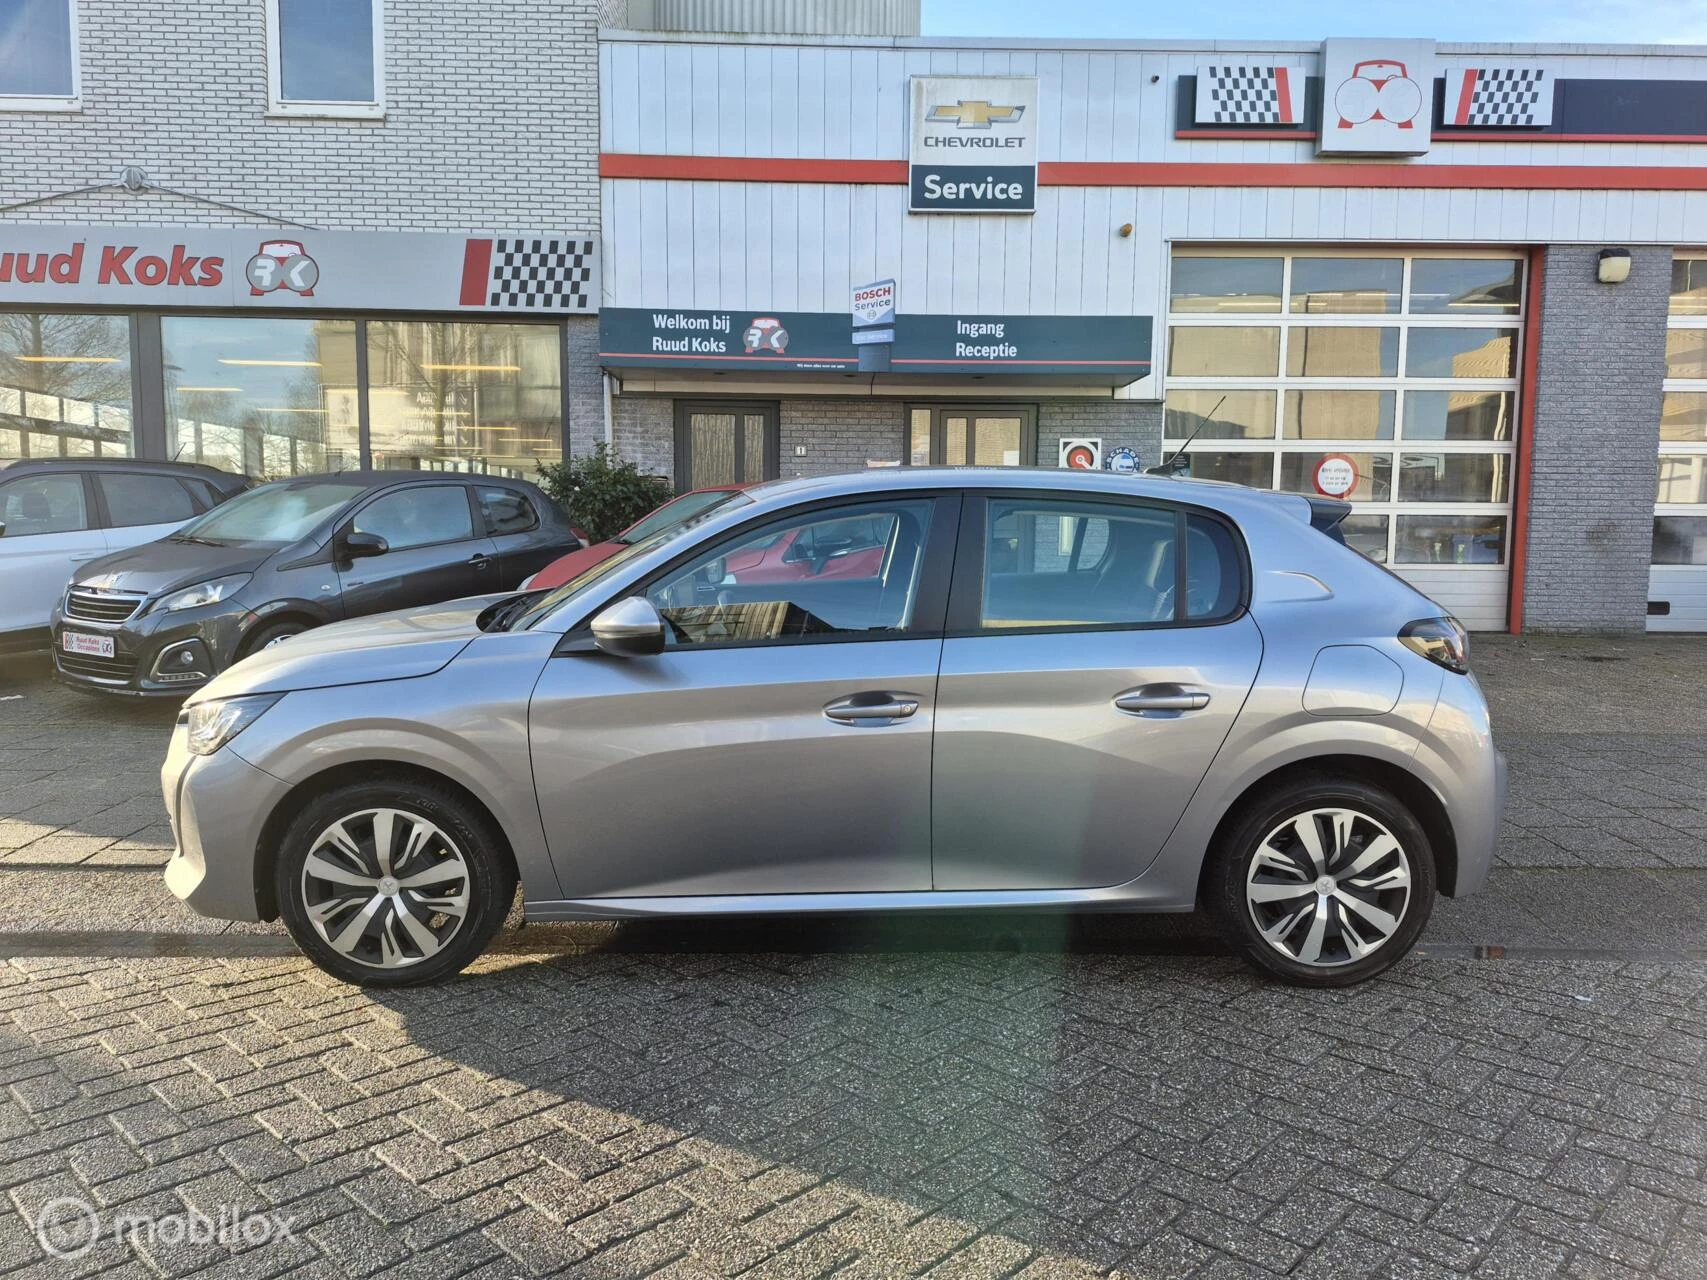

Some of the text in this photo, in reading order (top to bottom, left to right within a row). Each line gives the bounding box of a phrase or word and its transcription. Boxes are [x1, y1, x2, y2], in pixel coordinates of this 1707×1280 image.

[924, 136, 1026, 148] CHEVROLET
[924, 174, 1023, 200] Service
[98, 244, 225, 287] Koks
[854, 286, 892, 302] BOSCH
[854, 299, 891, 311] Service
[652, 314, 730, 334] Welkom bij
[957, 320, 1005, 338] Ingang
[652, 336, 727, 353] Ruud Koks
[955, 342, 1018, 360] Receptie
